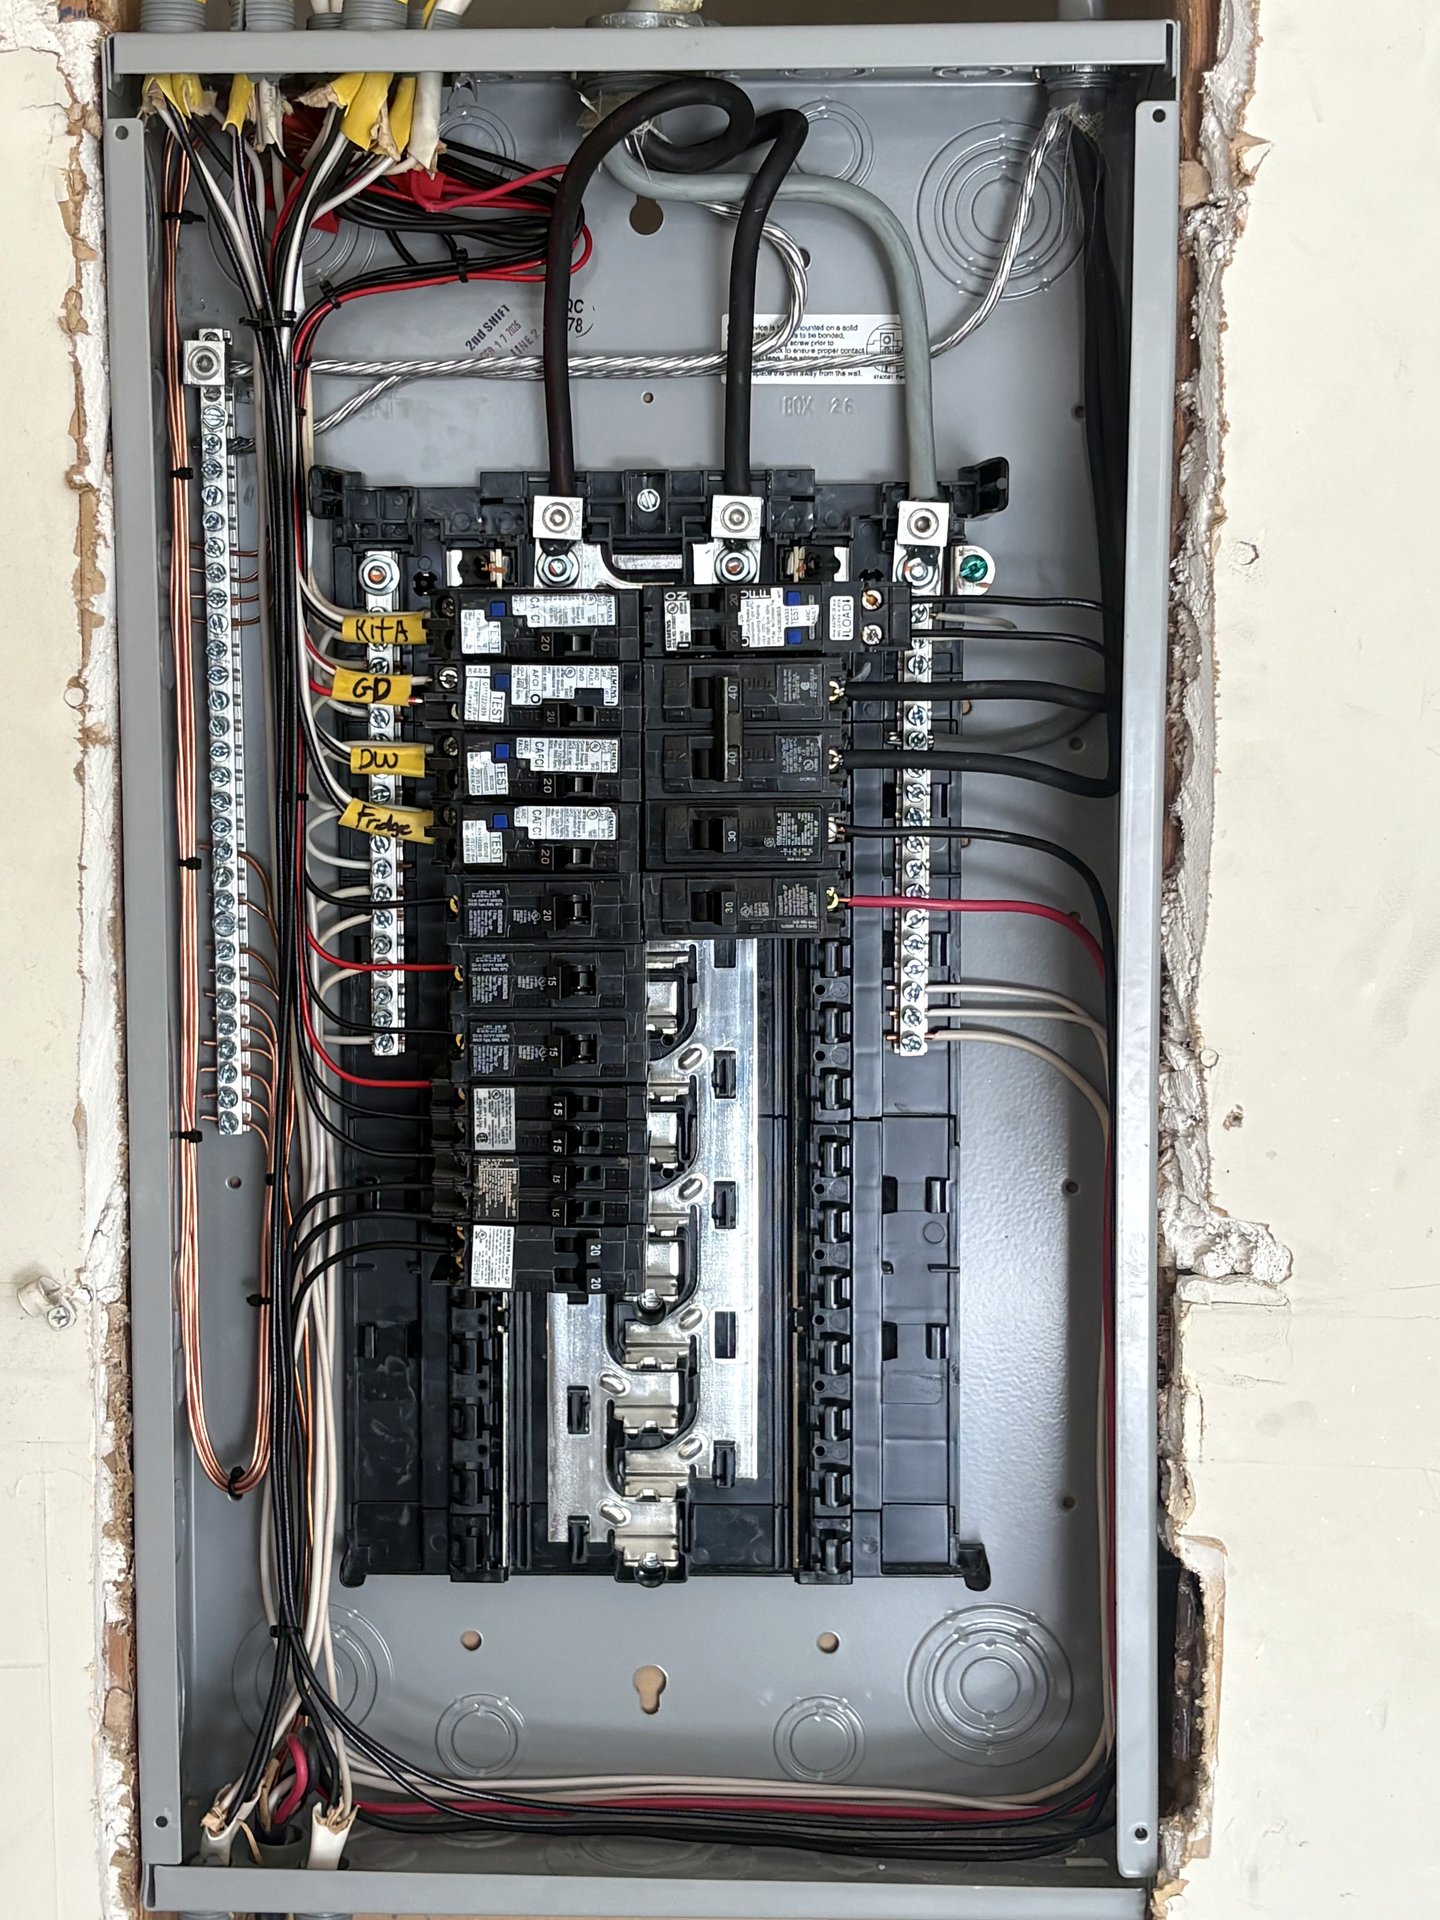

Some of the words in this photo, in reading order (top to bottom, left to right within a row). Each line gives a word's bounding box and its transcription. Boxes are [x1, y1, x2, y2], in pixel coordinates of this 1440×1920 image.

[465, 328, 486, 351] 2nd
[483, 304, 511, 332] SHIFT
[531, 329, 541, 339] 2
[791, 608, 799, 624] TEST
[842, 604, 851, 633] LOAD
[541, 635, 550, 652] 20
[353, 677, 391, 702] GD
[729, 685, 737, 700] 40
[492, 695, 503, 722] TEST
[359, 749, 398, 770] DW
[729, 751, 737, 765] 40
[497, 765, 506, 792] TEST
[543, 778, 552, 794] 20
[357, 805, 413, 837] Fridge
[728, 831, 737, 842] 30
[492, 834, 501, 861] TEST
[541, 849, 550, 865] 20
[725, 902, 734, 913] 30
[543, 909, 552, 922] 20
[547, 976, 557, 987] 15
[549, 1047, 559, 1057] 15
[553, 1101, 562, 1116] 15
[553, 1138, 562, 1153] 15
[552, 1175, 560, 1183] 15
[552, 1208, 560, 1218] 15
[590, 1244, 600, 1256] 20
[591, 1277, 601, 1290] 20
